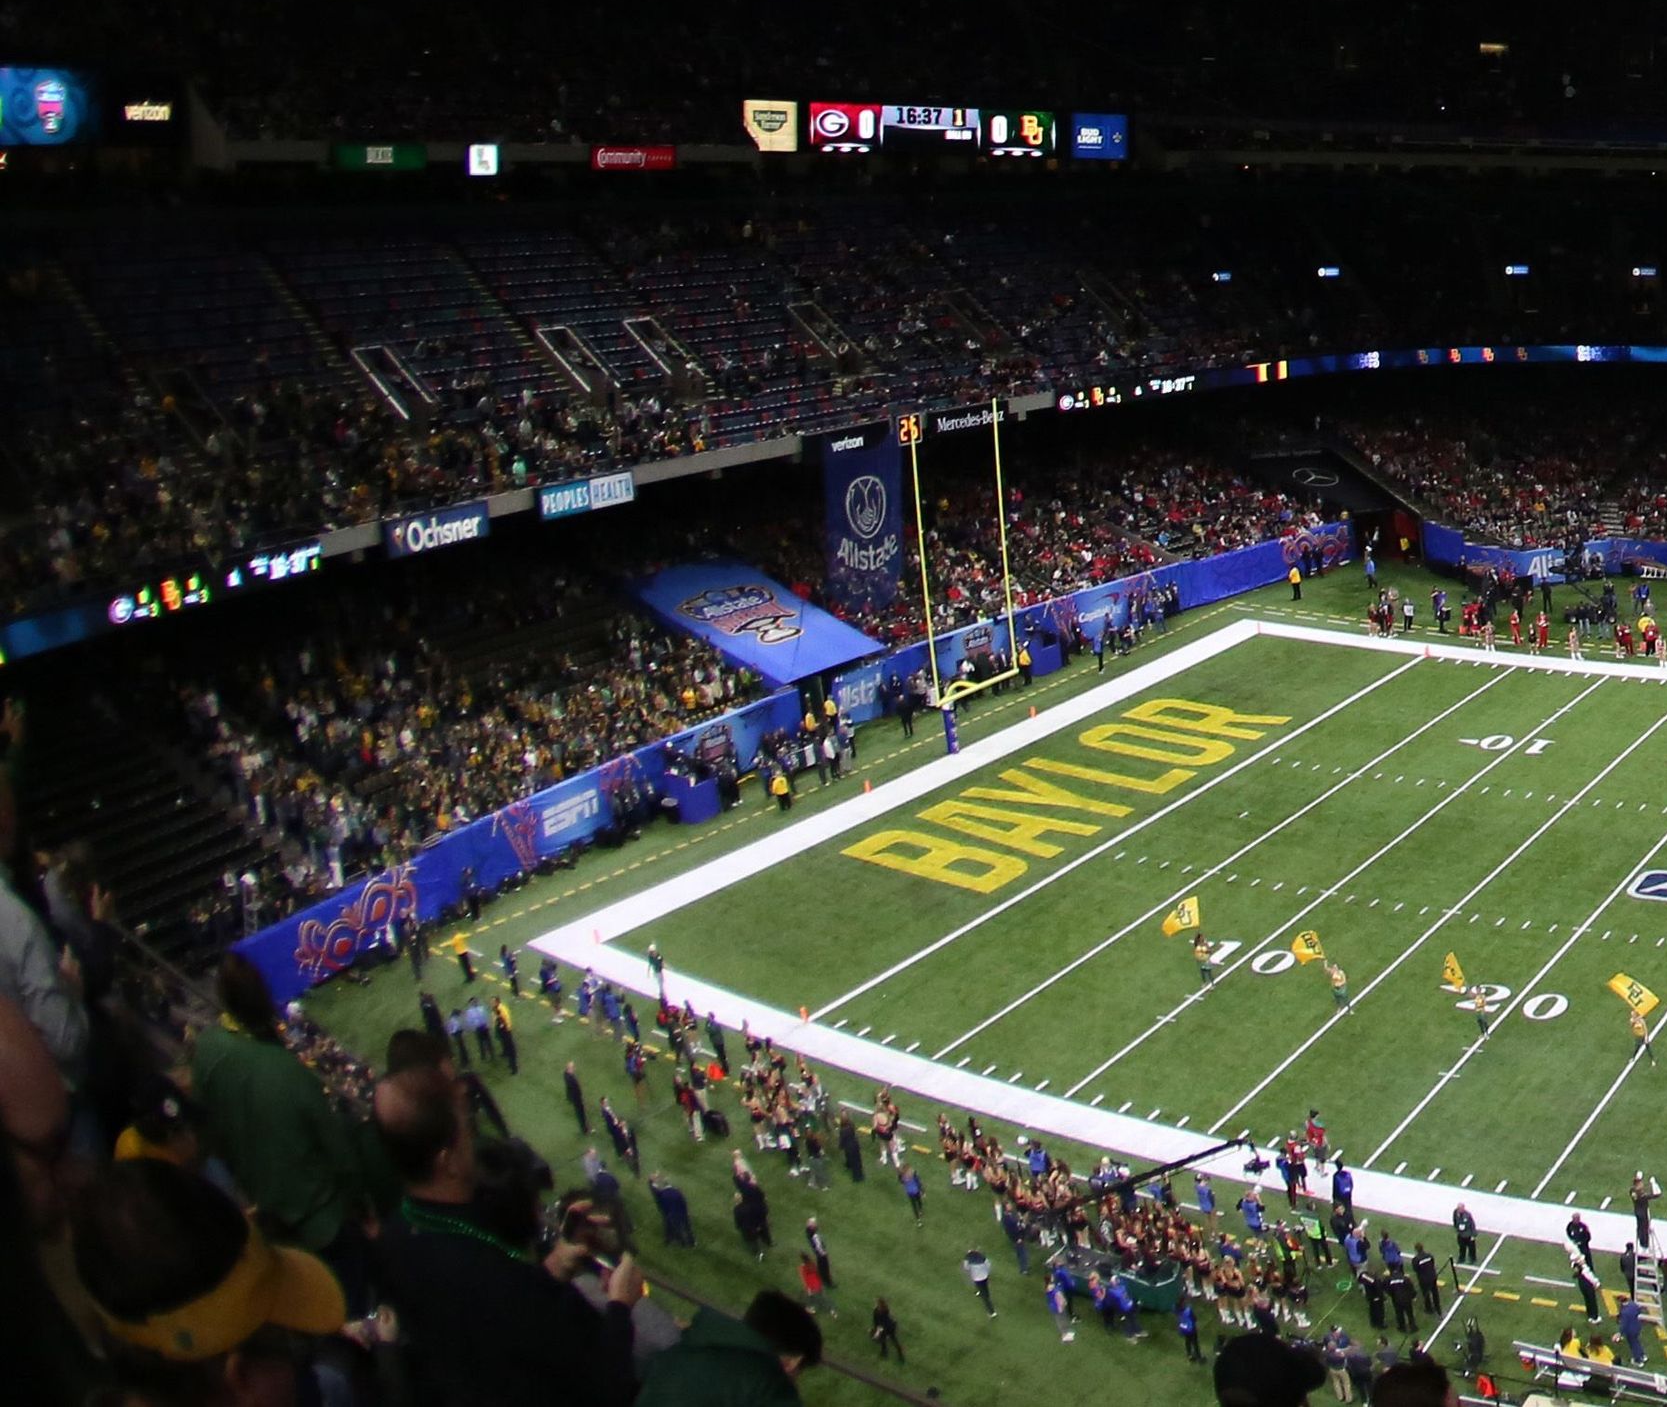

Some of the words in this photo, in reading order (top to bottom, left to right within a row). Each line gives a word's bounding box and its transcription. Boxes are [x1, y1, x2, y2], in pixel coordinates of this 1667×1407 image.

[896, 107, 942, 125] 16:37
[954, 109, 964, 126] 1
[831, 436, 864, 452] verizon
[542, 487, 590, 515] PEOPLES
[407, 515, 482, 552] Ochsner
[836, 534, 899, 571] Allstate
[543, 790, 599, 838] ESPN
[840, 699, 1293, 894] BAYLOR
